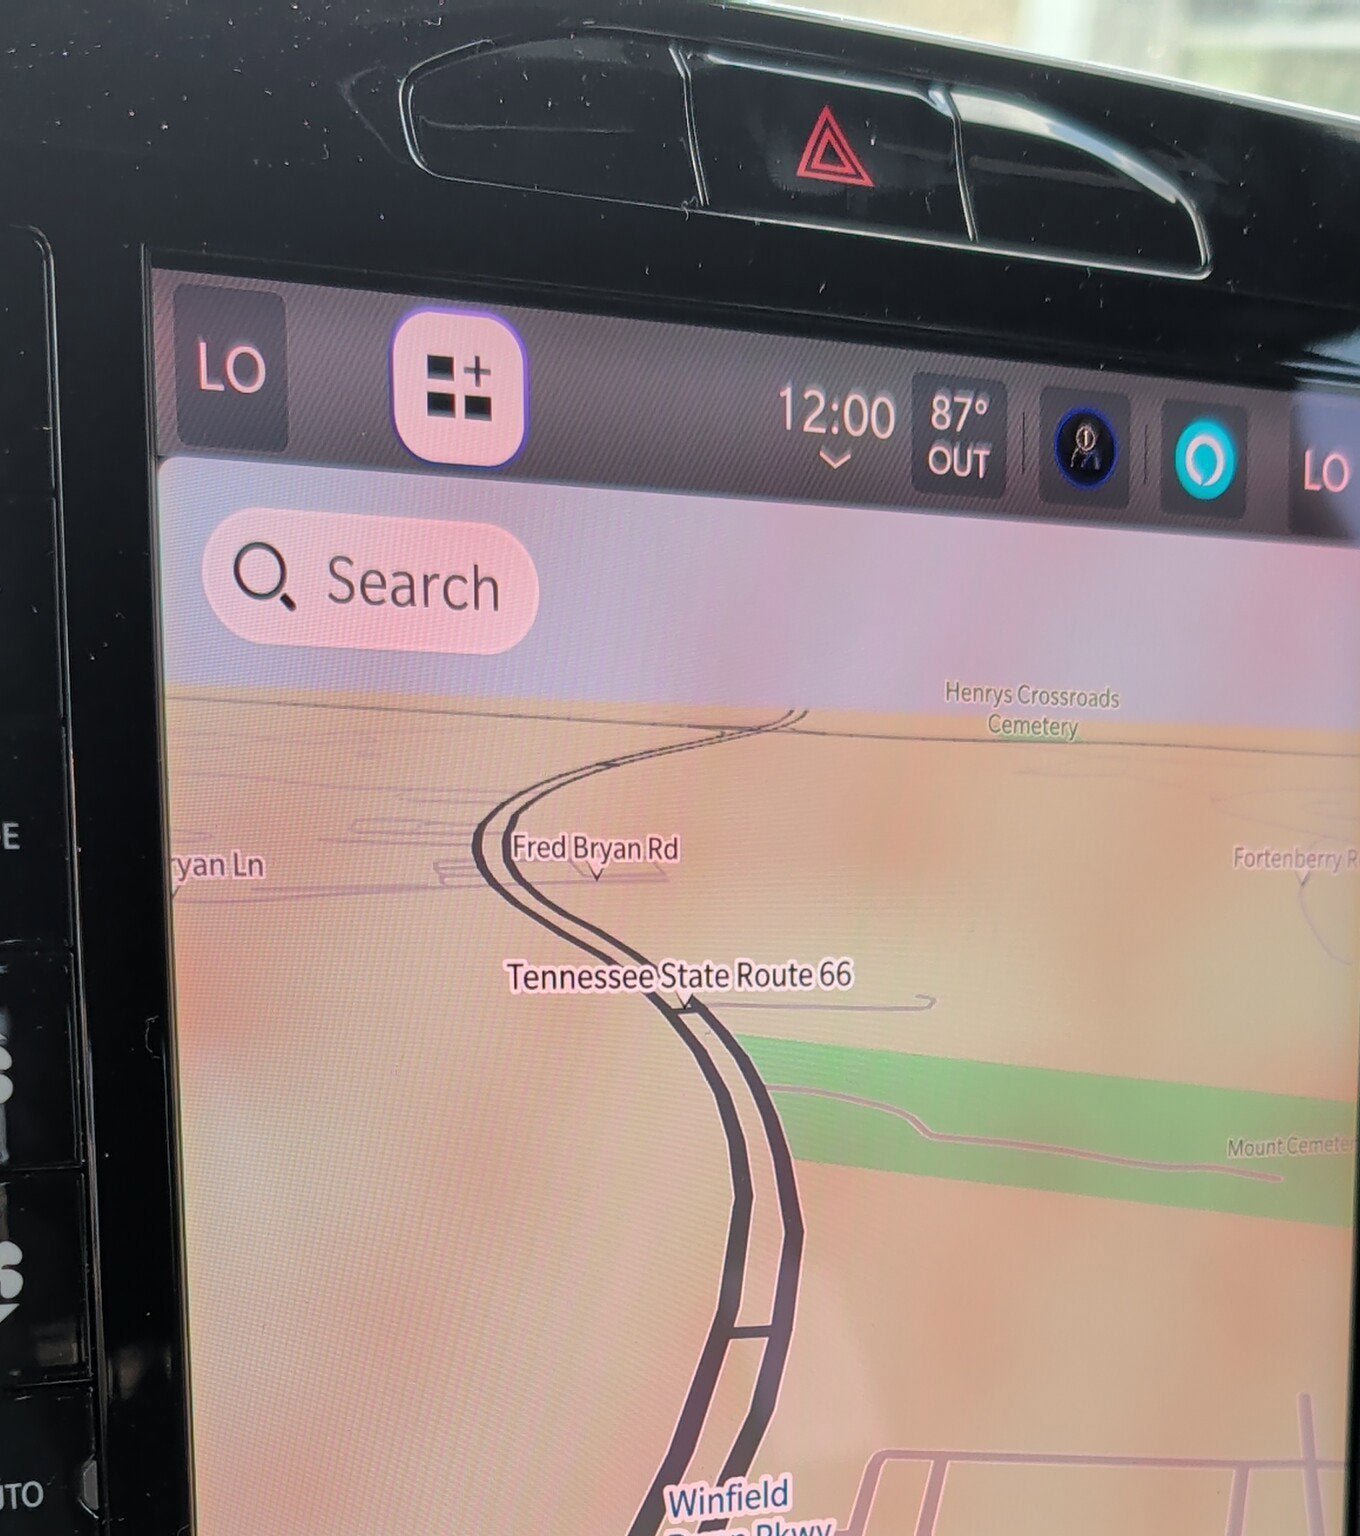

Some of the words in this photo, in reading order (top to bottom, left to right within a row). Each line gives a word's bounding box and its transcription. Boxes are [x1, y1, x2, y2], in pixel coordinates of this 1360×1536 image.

[197, 340, 266, 394] LO
[779, 386, 896, 440] 12:00
[931, 393, 989, 432] 87°
[929, 446, 991, 480] OUT
[1304, 449, 1351, 493] LO
[327, 555, 500, 612] Search
[945, 681, 1012, 707] Henrys
[1017, 685, 1120, 709] Crossroads
[988, 714, 1078, 740] Cemetery
[233, 852, 264, 877] Ln
[513, 836, 566, 861] Fred
[574, 837, 640, 866] Bryan
[648, 838, 678, 861] Rd
[1234, 846, 1342, 873] Fortenberry
[507, 963, 654, 991] Tennessee
[661, 962, 730, 989] State
[737, 962, 814, 989] Route
[820, 960, 852, 987] 66
[1228, 1138, 1284, 1157] Mount
[667, 1480, 789, 1518] Winfield
